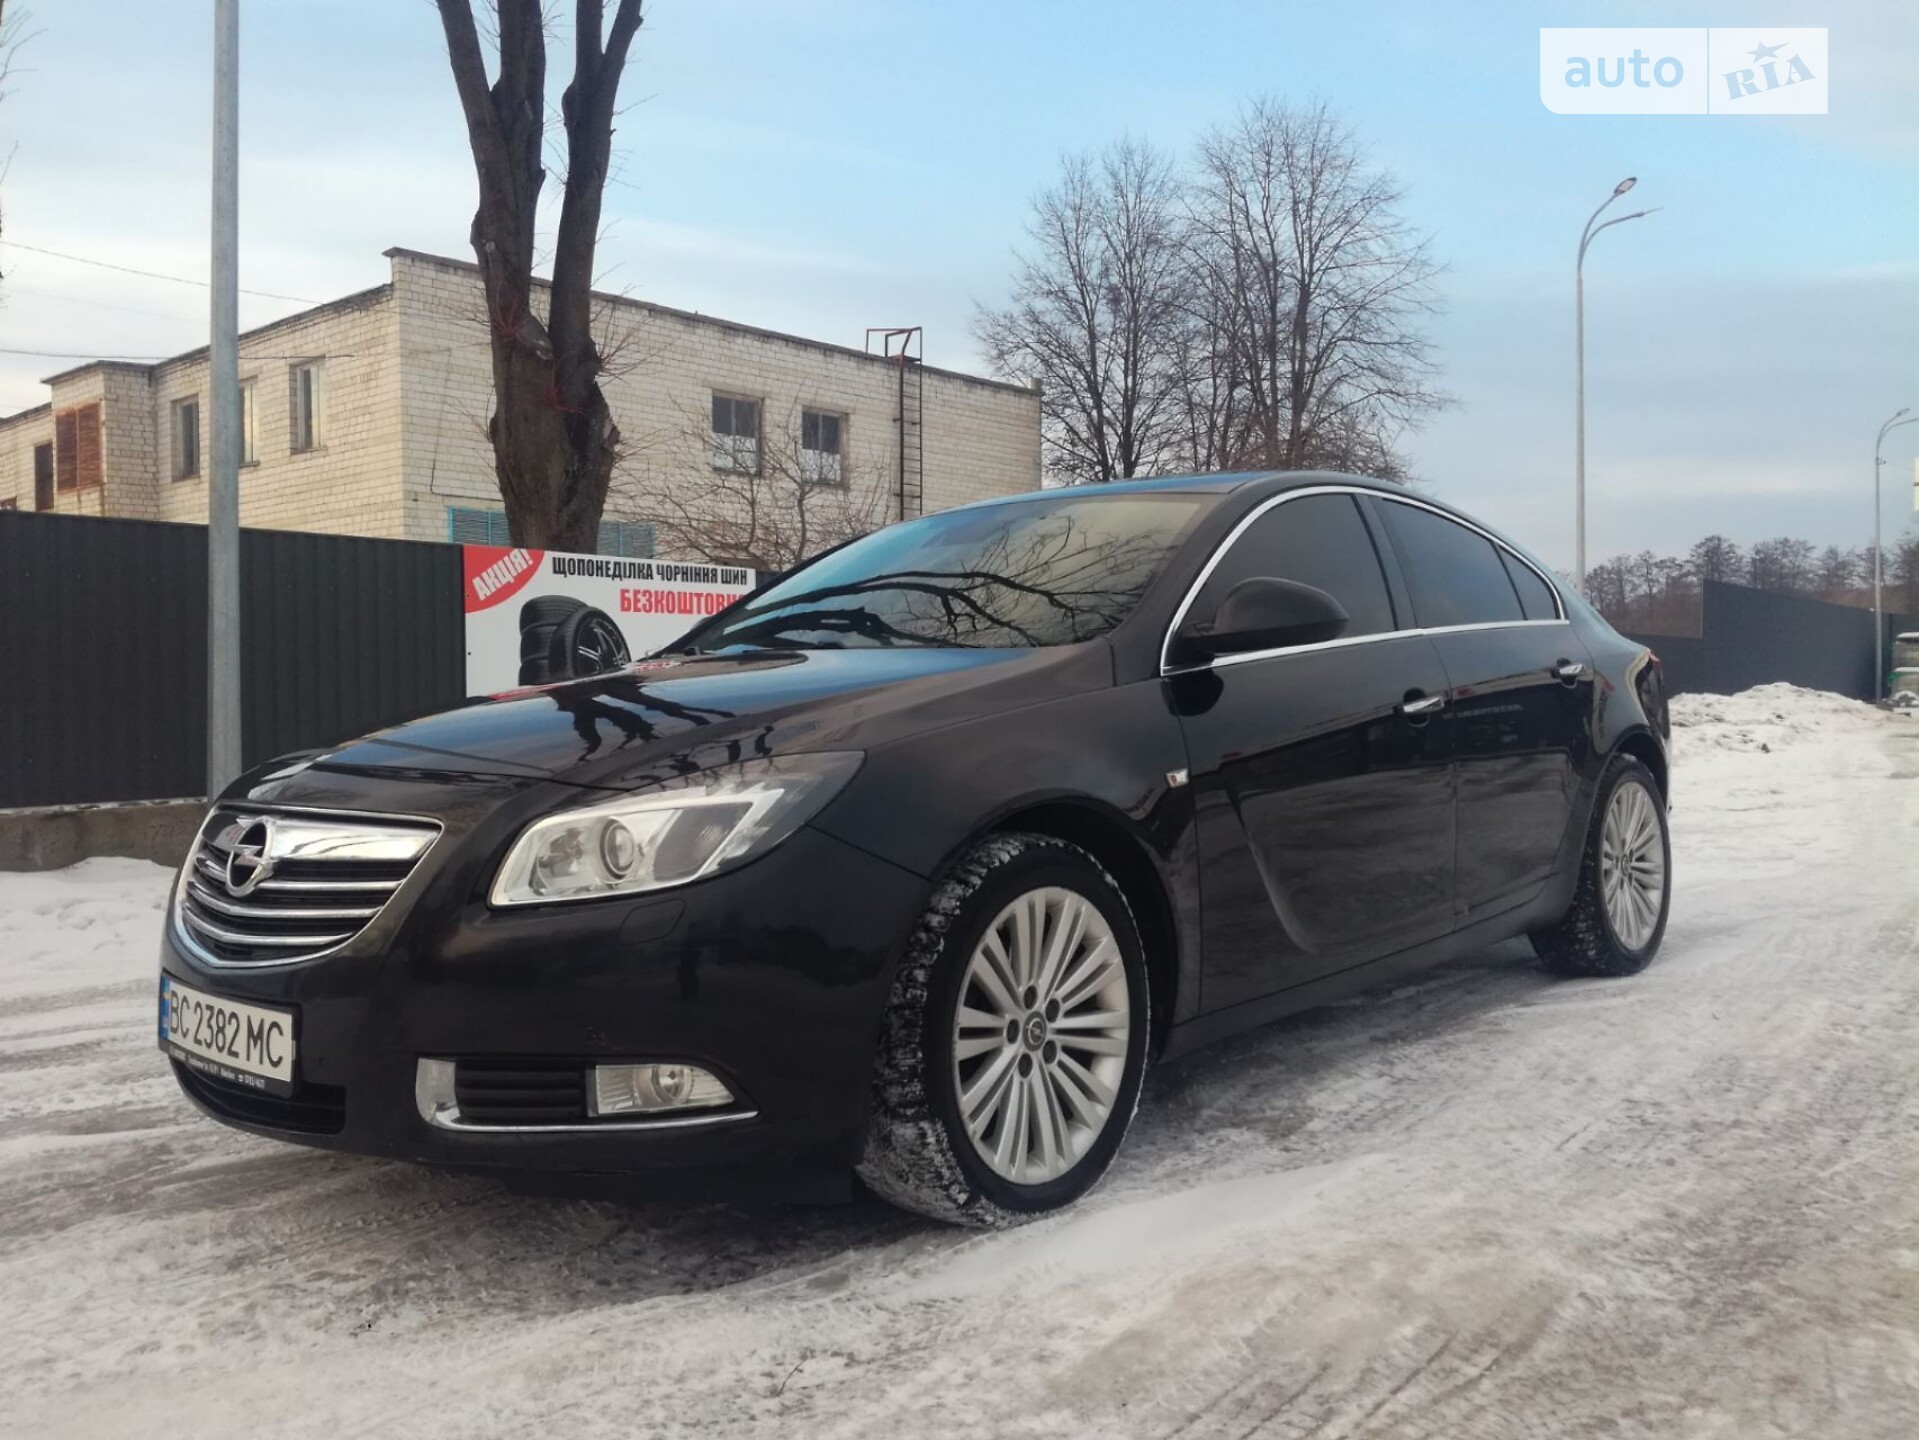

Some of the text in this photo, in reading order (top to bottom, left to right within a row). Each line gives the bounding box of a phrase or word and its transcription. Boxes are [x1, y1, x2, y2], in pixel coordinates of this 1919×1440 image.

[472, 548, 533, 601] АКЦІЯ!
[552, 556, 748, 585] ЩОПОНЕДІЛКА ЧОРНІННЯ ШИН
[620, 588, 745, 616] БЕЗКОШТОВ
[170, 990, 190, 1039] BC
[193, 1001, 240, 1059] 2382
[246, 1015, 284, 1068] MC
